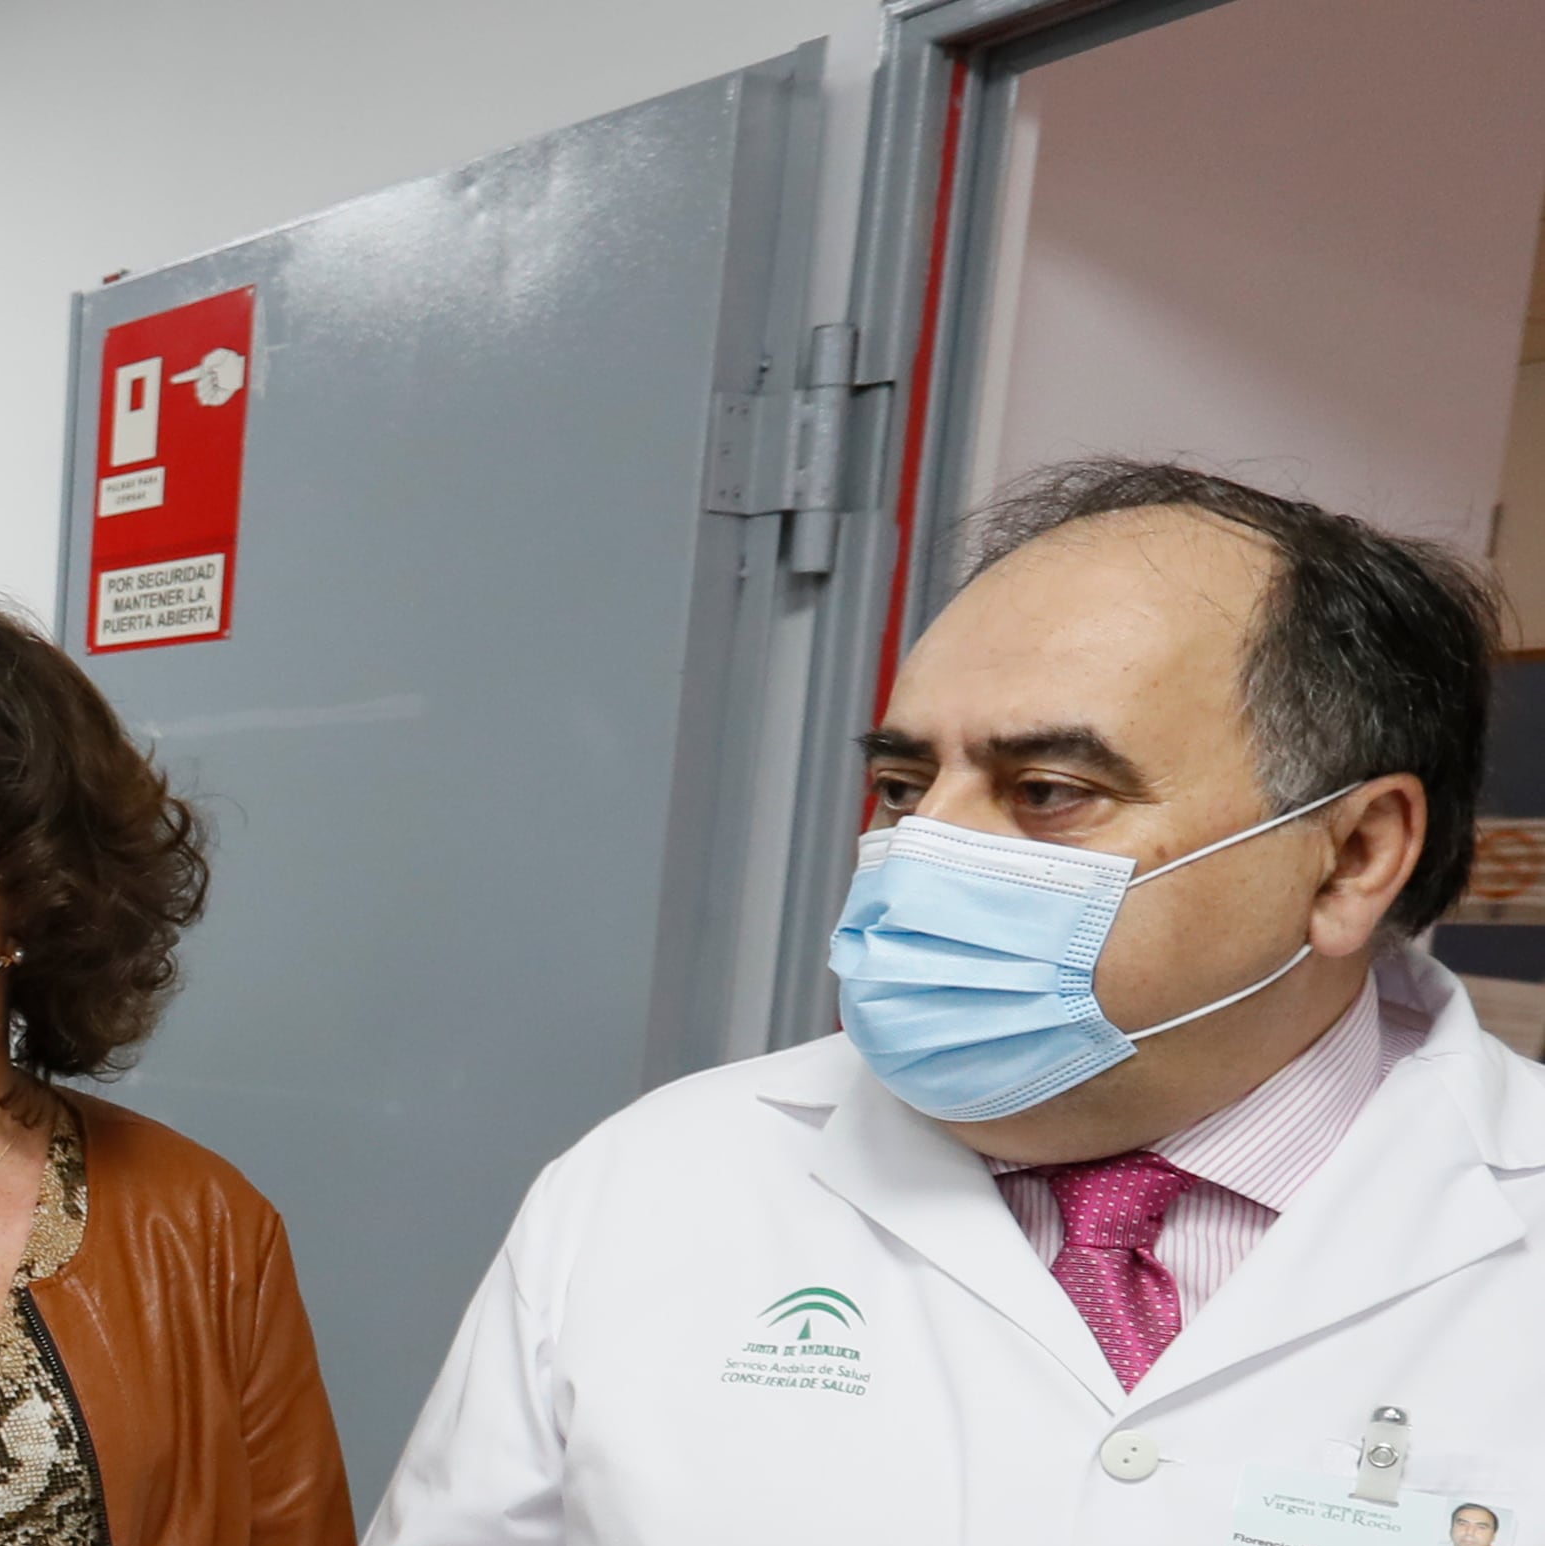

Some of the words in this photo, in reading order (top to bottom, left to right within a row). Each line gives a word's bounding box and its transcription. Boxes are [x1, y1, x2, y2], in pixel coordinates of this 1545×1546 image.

[107, 576, 134, 593] POR
[137, 563, 216, 590] SEGURIDAD
[113, 588, 184, 613] MANTENER
[188, 586, 206, 603] LA
[102, 615, 154, 634] PUERTA
[156, 605, 216, 627] ABIERTA
[742, 1342, 779, 1356] JUNTA
[782, 1345, 797, 1357] DE
[724, 1357, 768, 1372] Servicio
[770, 1363, 816, 1375] Andaluz
[818, 1364, 834, 1376] de
[837, 1365, 871, 1383] Salud
[799, 1377, 817, 1389] DE
[820, 1378, 866, 1396] SALUD
